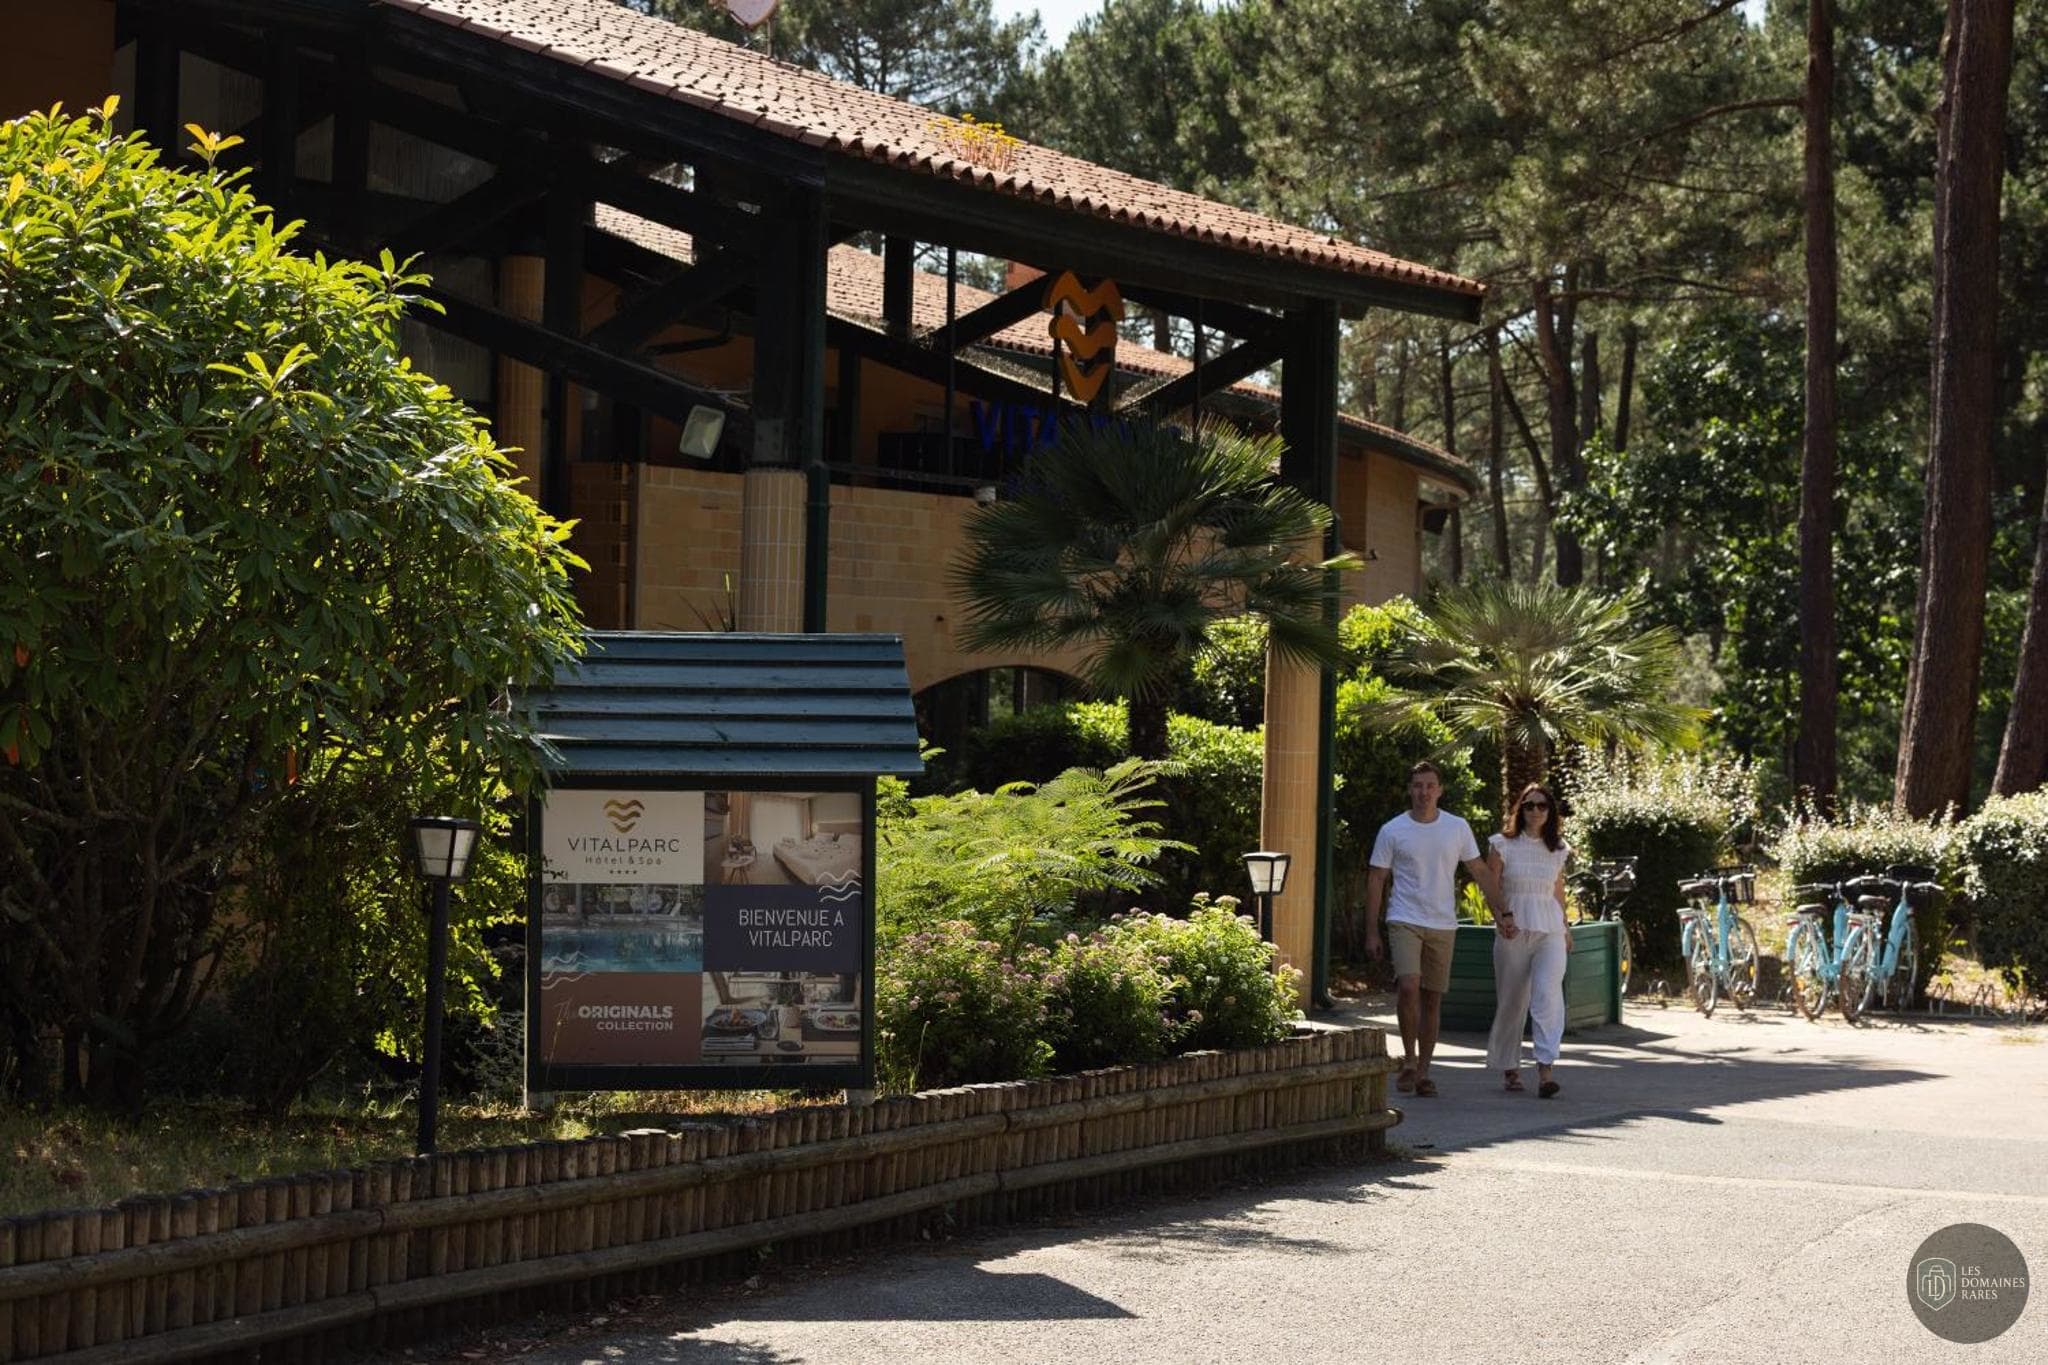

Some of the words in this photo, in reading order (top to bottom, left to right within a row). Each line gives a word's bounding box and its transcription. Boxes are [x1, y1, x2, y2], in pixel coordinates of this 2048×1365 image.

[568, 837, 680, 853] VITALPARC
[628, 855, 635, 865] &
[640, 856, 663, 866] Spa
[739, 909, 829, 926] BIENVENUE
[833, 911, 845, 926] A
[749, 931, 833, 947] VITALPARC
[578, 1005, 673, 1018] ORIGINALS
[596, 1021, 673, 1031] COLLECTION
